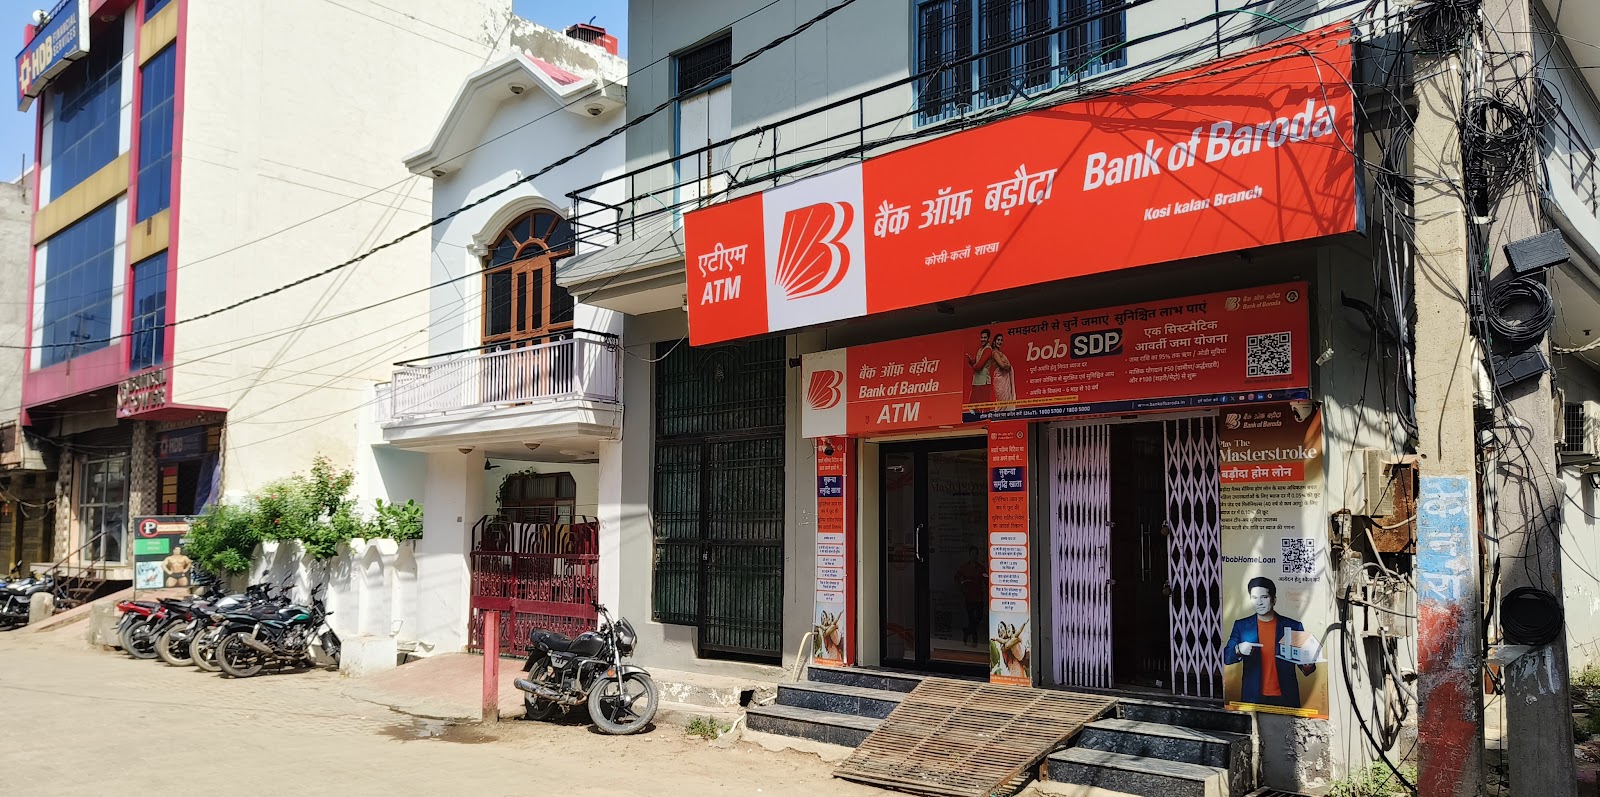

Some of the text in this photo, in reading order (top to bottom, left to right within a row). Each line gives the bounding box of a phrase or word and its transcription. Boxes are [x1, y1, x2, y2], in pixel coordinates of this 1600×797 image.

[31, 35, 53, 80] HDB
[1083, 98, 1336, 191] Bank of Baroda
[874, 163, 1058, 238] बैंक ऑफ़ बड़ौदा
[1143, 185, 1262, 221] Kosi kalan Branch
[975, 242, 1000, 256] शाखा
[698, 243, 748, 278] एटीएम
[701, 275, 741, 306] ATM
[1243, 302, 1255, 310] Bank
[1007, 301, 1207, 336] समझदारी से चुनें जमाएं सुनिश्चित लाभ पाएं
[1144, 319, 1218, 339] एक सिस्टमैटिक
[1026, 331, 1121, 362] bob SDP
[1135, 333, 1228, 352] आवर्ती जमा योजना
[859, 357, 940, 380] बैंक ऑफ़ बड़ौदा
[859, 379, 939, 399] Bank of Baroda
[877, 402, 920, 424] ATM
[1243, 421, 1256, 429] Bank
[1263, 420, 1282, 428] Baroda
[1219, 445, 1318, 463] Masterstroke
[998, 468, 1016, 478] सुकन्या
[1221, 465, 1292, 481] बड़ौदा होम लोन
[993, 479, 1022, 490] समृद्धि खाता
